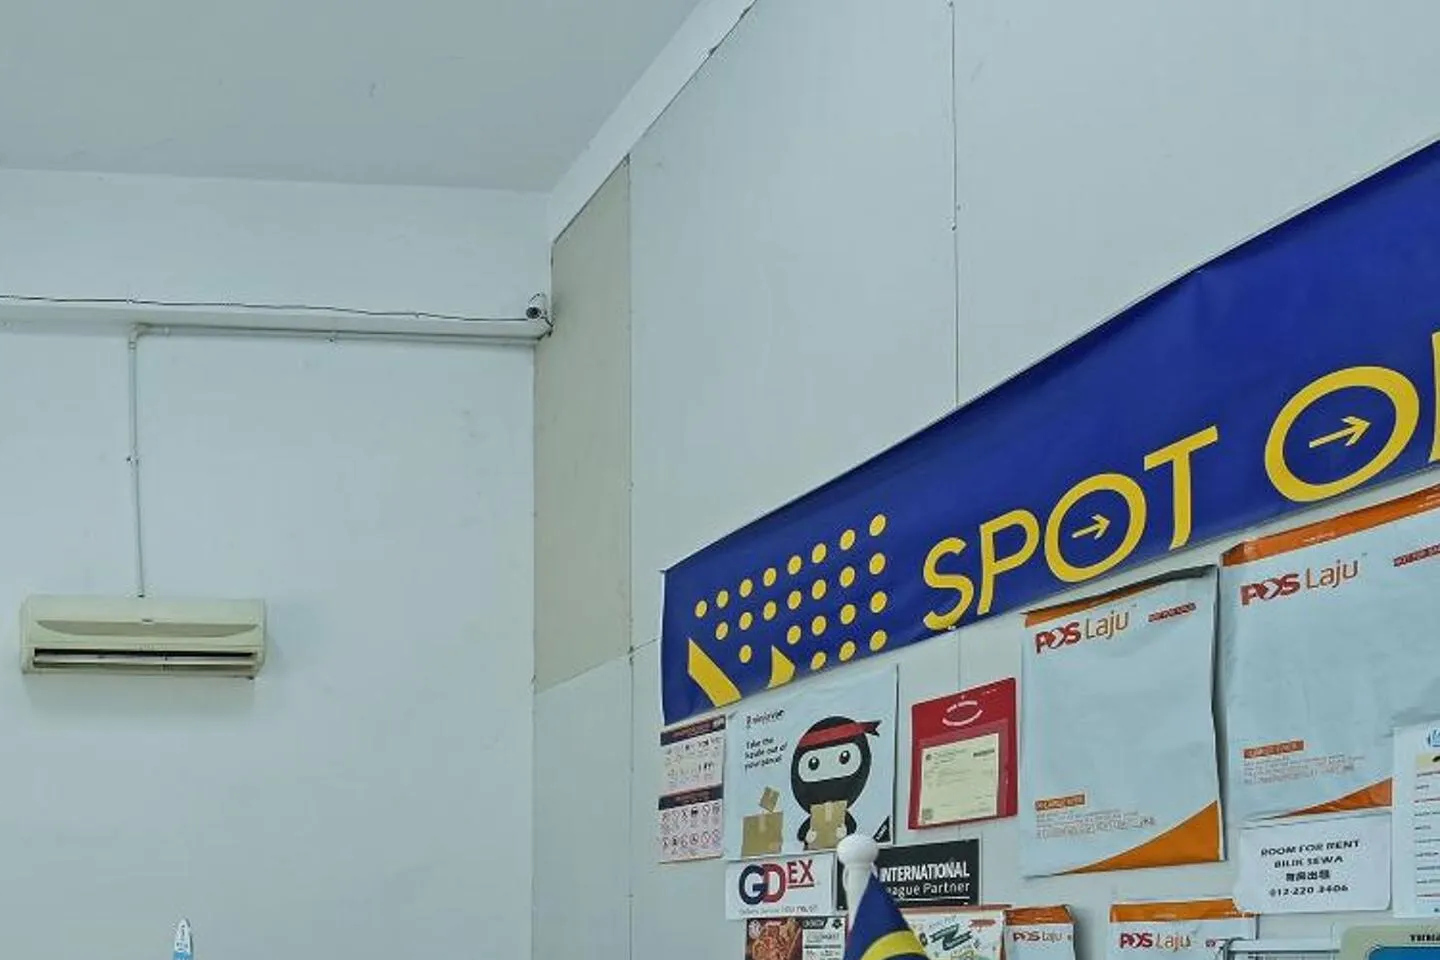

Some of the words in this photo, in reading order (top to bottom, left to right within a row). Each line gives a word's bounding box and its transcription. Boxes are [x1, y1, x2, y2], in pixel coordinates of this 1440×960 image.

[922, 426, 1219, 632] SPOT
[1264, 330, 1440, 502] O
[1240, 573, 1301, 606] POS
[1306, 559, 1359, 589] Laju
[1034, 622, 1082, 654] POS
[1086, 610, 1129, 640] Laju
[1261, 845, 1296, 857] ROOM
[1298, 843, 1324, 853] FOR
[1326, 839, 1361, 850] RENT
[880, 861, 970, 882] INTERNATIONAL
[1274, 859, 1305, 869] BILIK
[1308, 855, 1344, 866] SEWA
[738, 860, 815, 905] GDEX
[923, 882, 970, 894] Partner
[1120, 932, 1153, 949] POS
[1156, 932, 1191, 952] Laju
